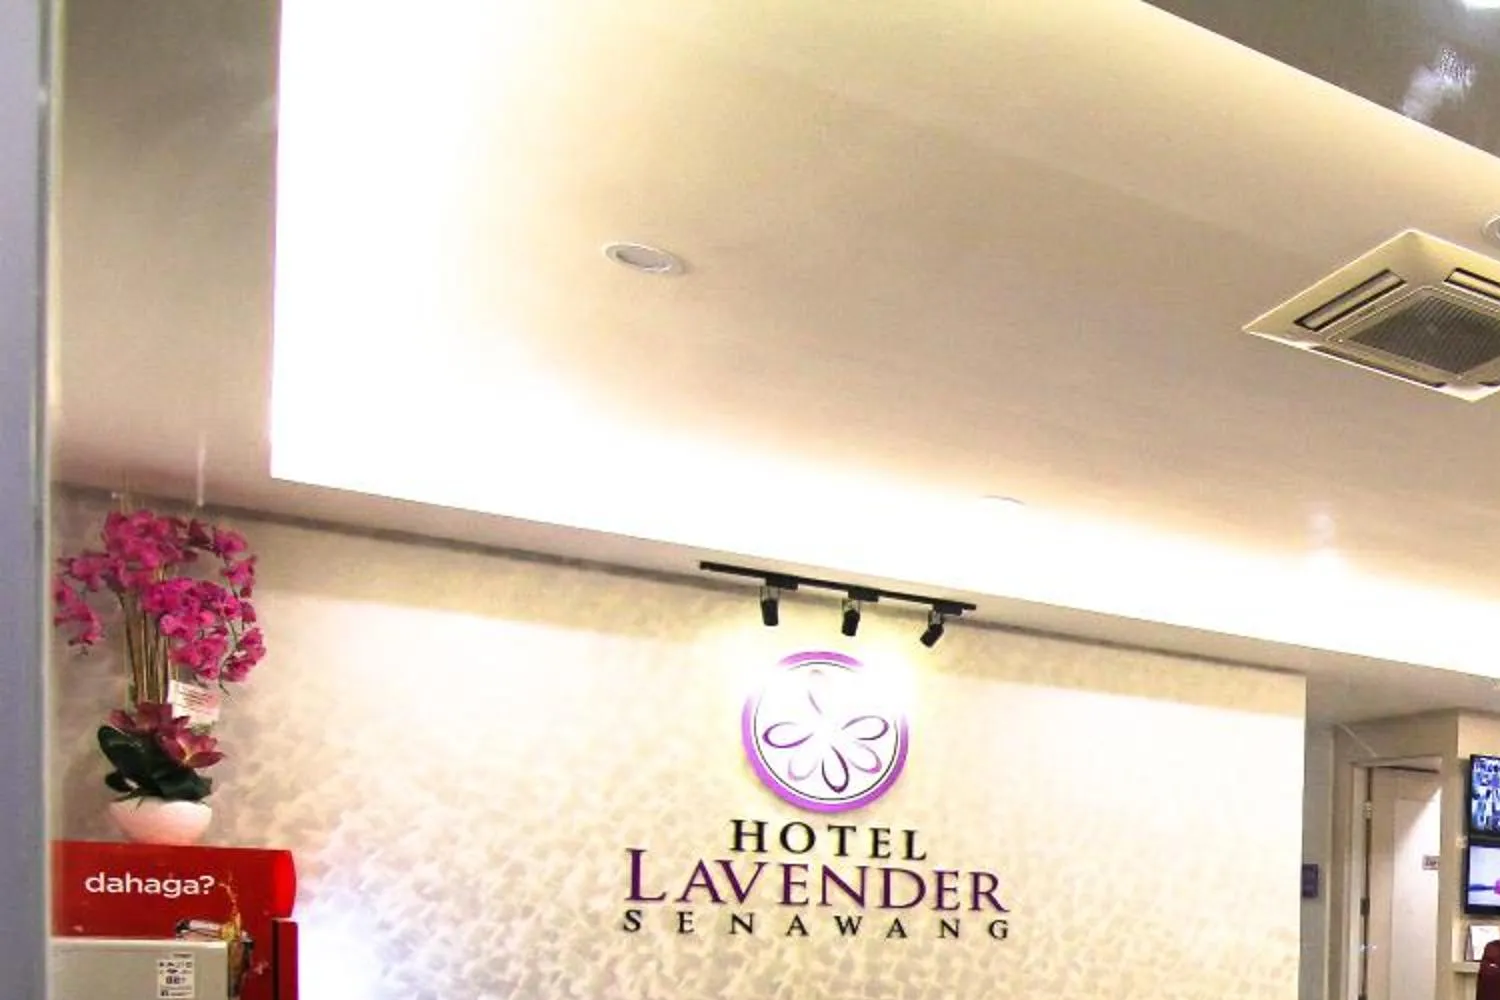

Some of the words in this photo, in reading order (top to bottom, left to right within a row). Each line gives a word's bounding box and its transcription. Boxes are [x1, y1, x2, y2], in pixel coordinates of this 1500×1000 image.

[729, 818, 928, 862] HOTEL
[84, 871, 216, 899] dahaga?
[623, 847, 1011, 914] LAVENDER
[622, 908, 1010, 940] SENAWANG
